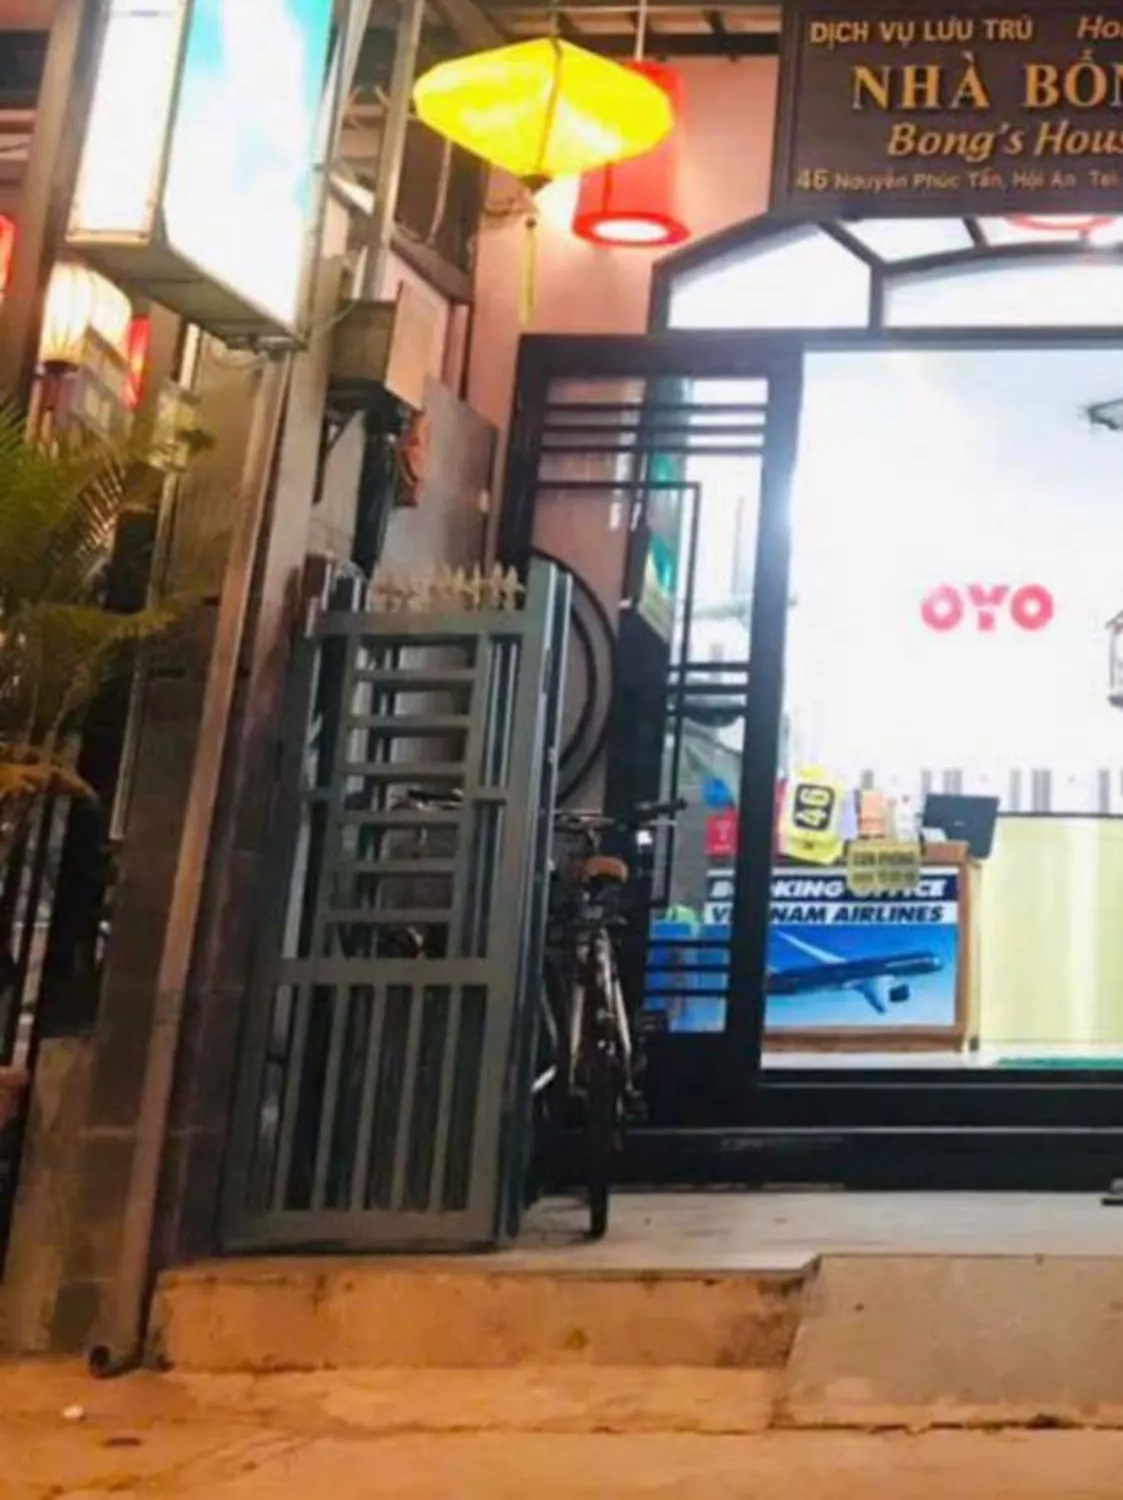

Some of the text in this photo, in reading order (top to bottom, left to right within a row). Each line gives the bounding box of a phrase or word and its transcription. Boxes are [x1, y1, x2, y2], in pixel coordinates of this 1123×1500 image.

[809, 20, 869, 49] DỊCH
[879, 20, 915, 48] VỤ
[852, 51, 990, 110] NHÀ
[887, 116, 1025, 163] Bong's
[920, 583, 1055, 631] OYO
[711, 879, 843, 898] BKING
[711, 904, 944, 924] VNAM AIRLINES
